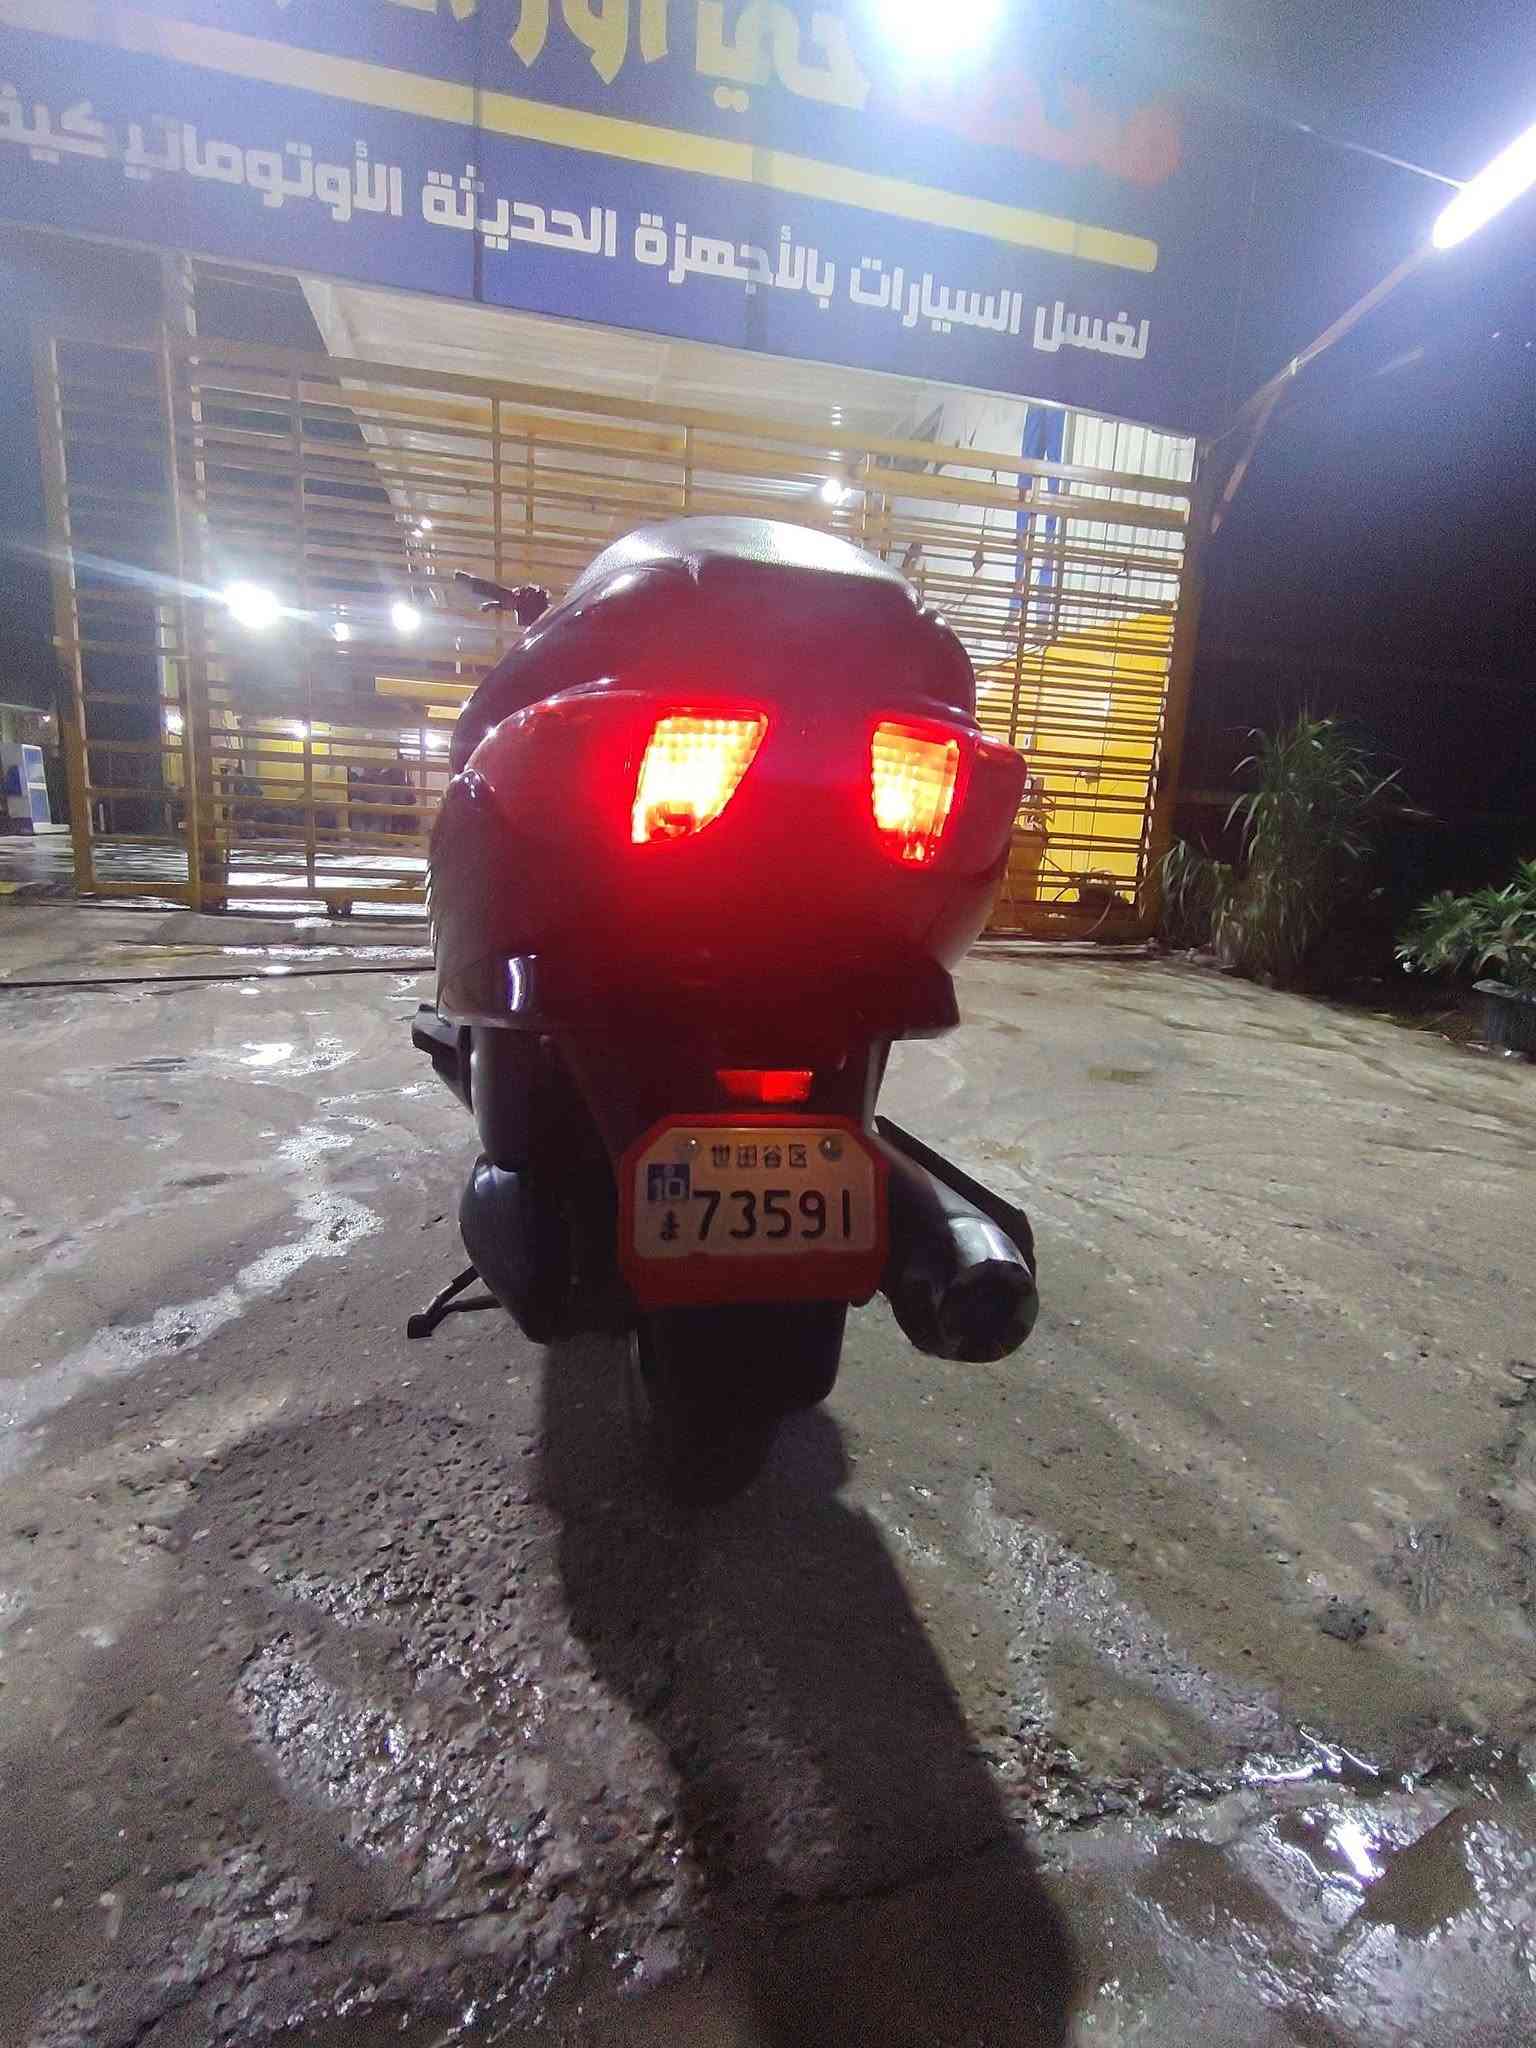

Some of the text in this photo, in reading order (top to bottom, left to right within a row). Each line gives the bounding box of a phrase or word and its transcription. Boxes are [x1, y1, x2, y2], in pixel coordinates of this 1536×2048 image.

[421, 163, 618, 257] الحديثة
[634, 212, 836, 309] بالأجهزة
[849, 257, 1023, 335] السيارات
[1033, 301, 1151, 359] لغسل
[692, 1189, 850, 1241] 73591
